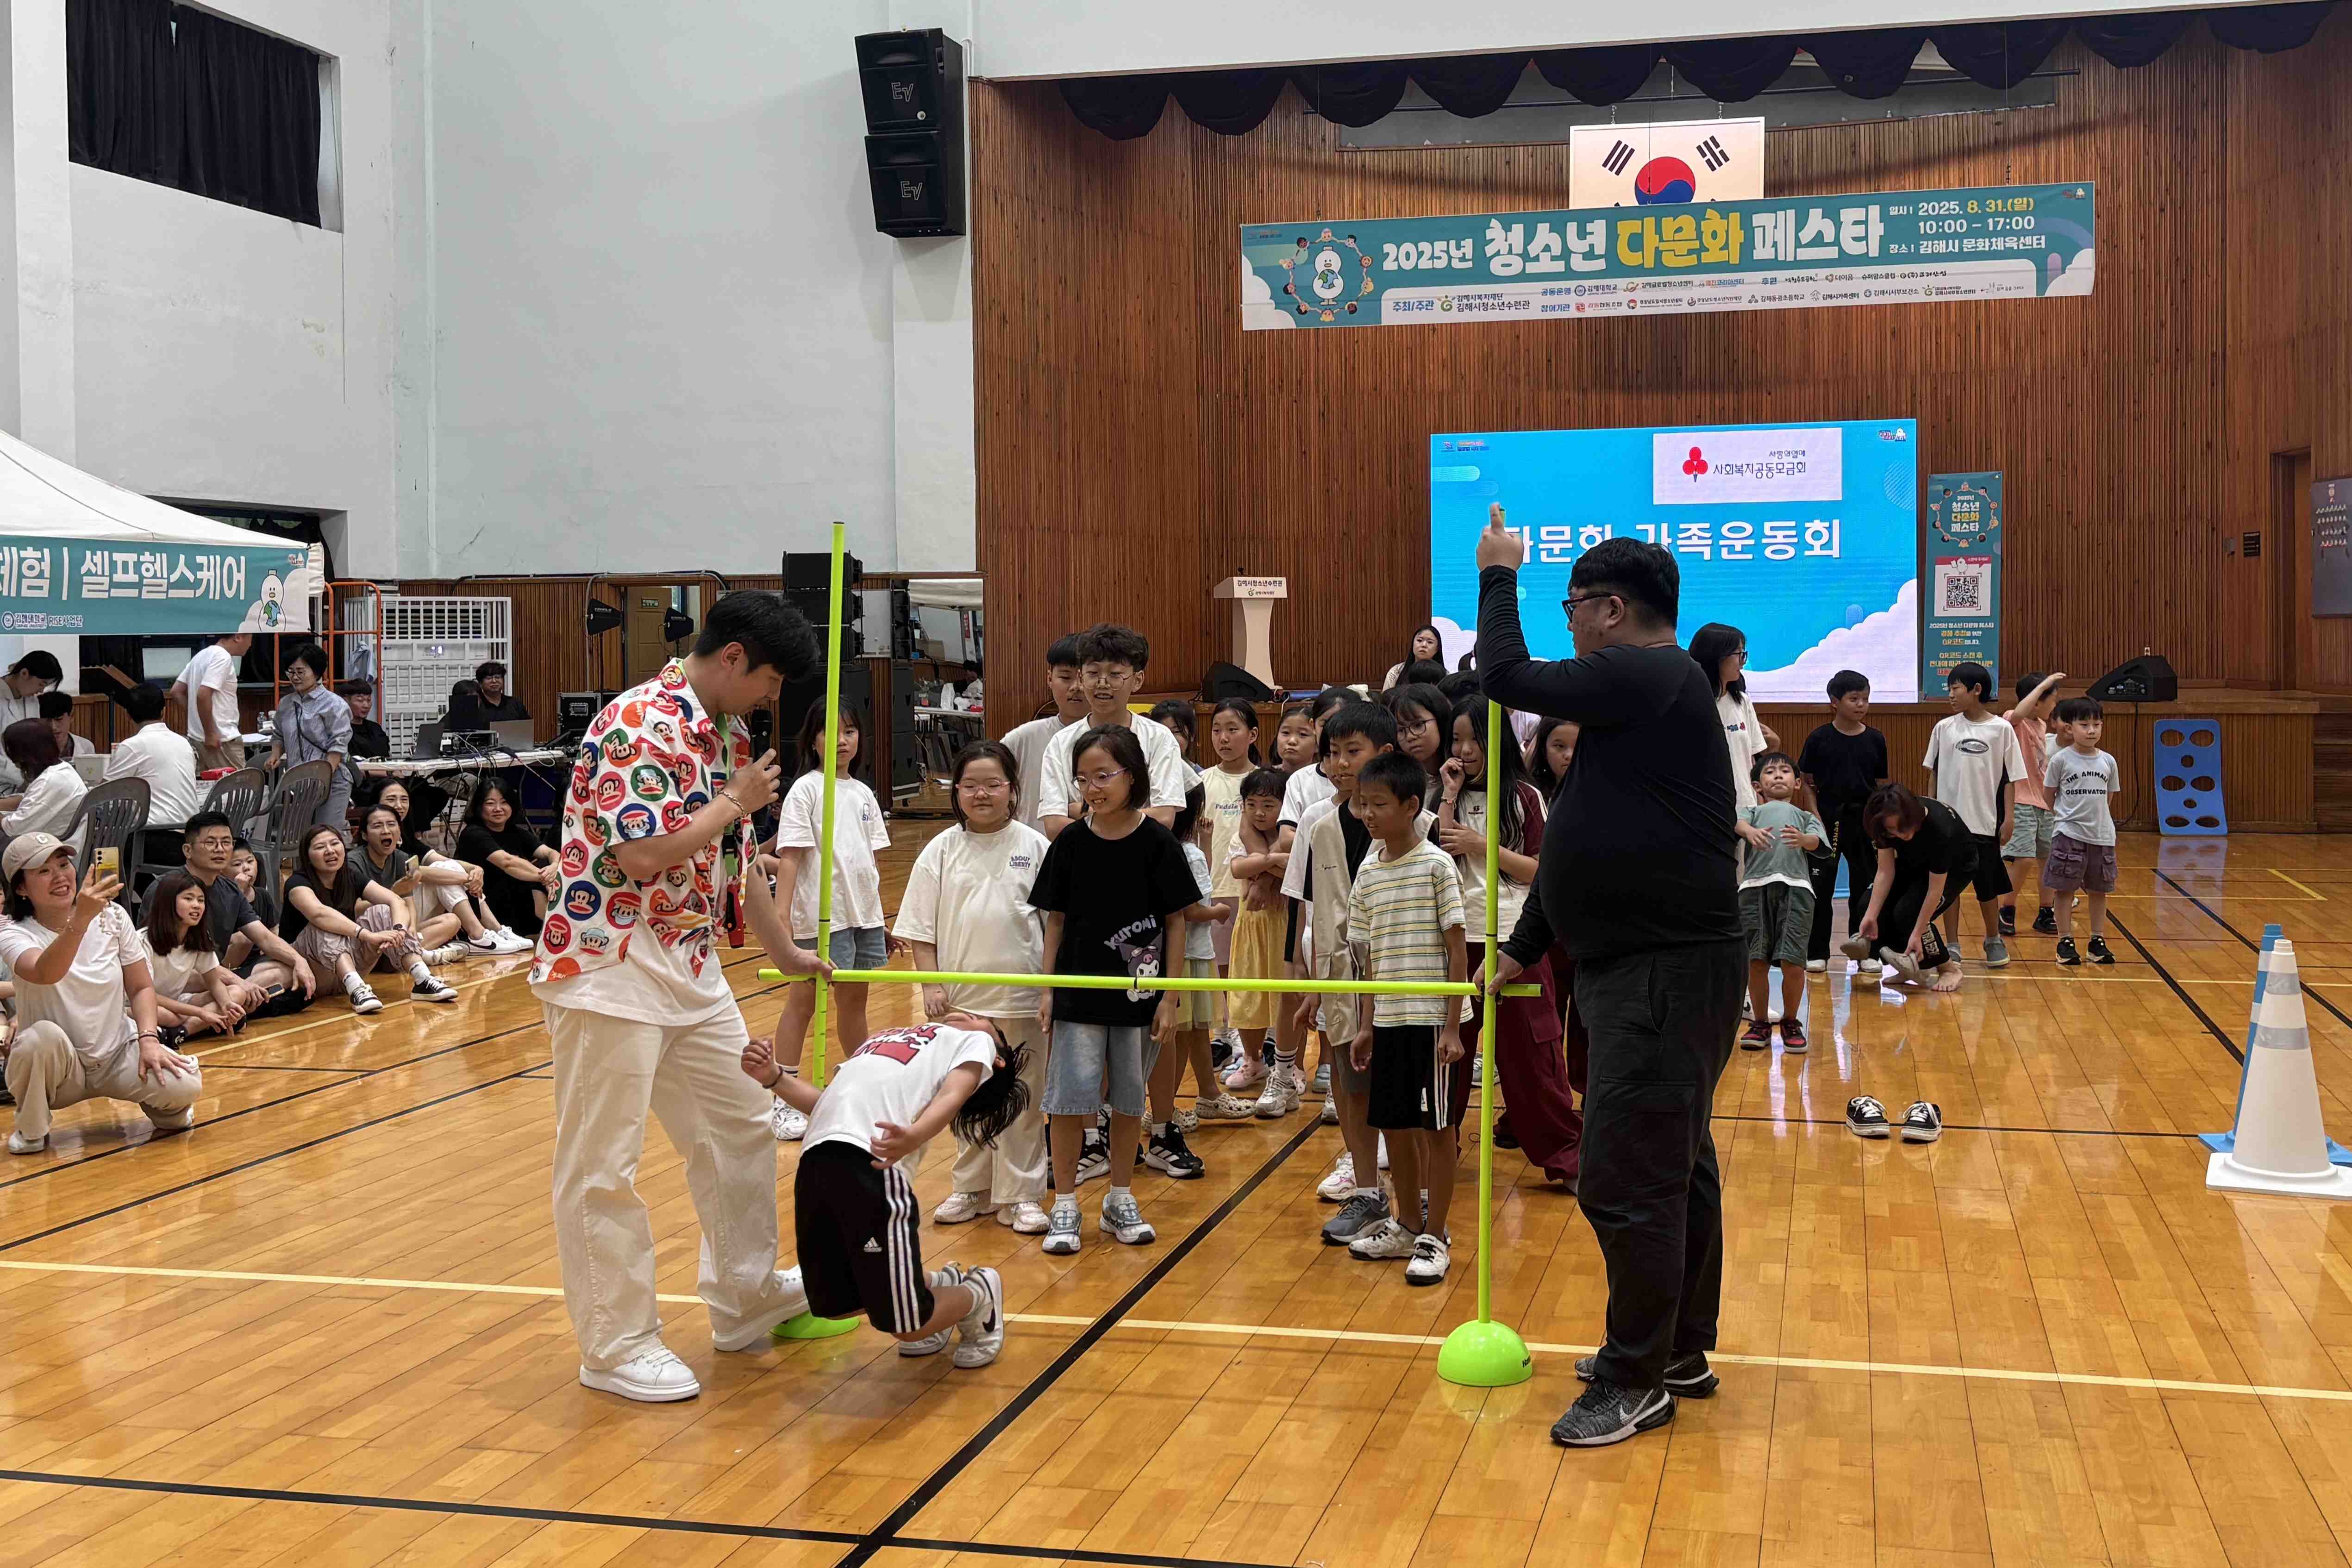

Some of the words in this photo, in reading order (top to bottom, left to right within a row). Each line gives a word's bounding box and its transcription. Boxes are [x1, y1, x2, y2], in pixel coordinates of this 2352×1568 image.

[1889, 206, 1908, 216] 일시
[1918, 201, 1963, 216] 2025.
[1967, 200, 1981, 213] 8.
[1985, 197, 2034, 212] 31.(일)
[1918, 219, 1967, 234] 10:00
[1987, 215, 2035, 231] 17:00
[1382, 238, 1473, 271] 2025년
[1484, 219, 1607, 276] 청소년
[1617, 207, 1744, 269] 다문화
[1752, 205, 1884, 262] 페스타
[1889, 244, 1908, 254] 장소
[1919, 240, 1959, 254] 김해시
[1963, 235, 2045, 252] 문화체육센터
[1540, 287, 1571, 296] 공동운영
[1392, 300, 1434, 312] 주최/주관
[1456, 300, 1530, 313] 김해시청소년수련관
[1541, 304, 1570, 312] 참여기관
[1713, 462, 1806, 479] 사회복지공동모금회
[1952, 501, 1980, 512] 청소년
[1952, 511, 1980, 522] 다문화
[1951, 522, 1979, 532] 페스타
[81, 550, 245, 600] 셀프헬스케어
[49, 615, 83, 627] RISE사업단
[2066, 773, 2078, 783] THE
[2082, 771, 2108, 782] ANIMAL
